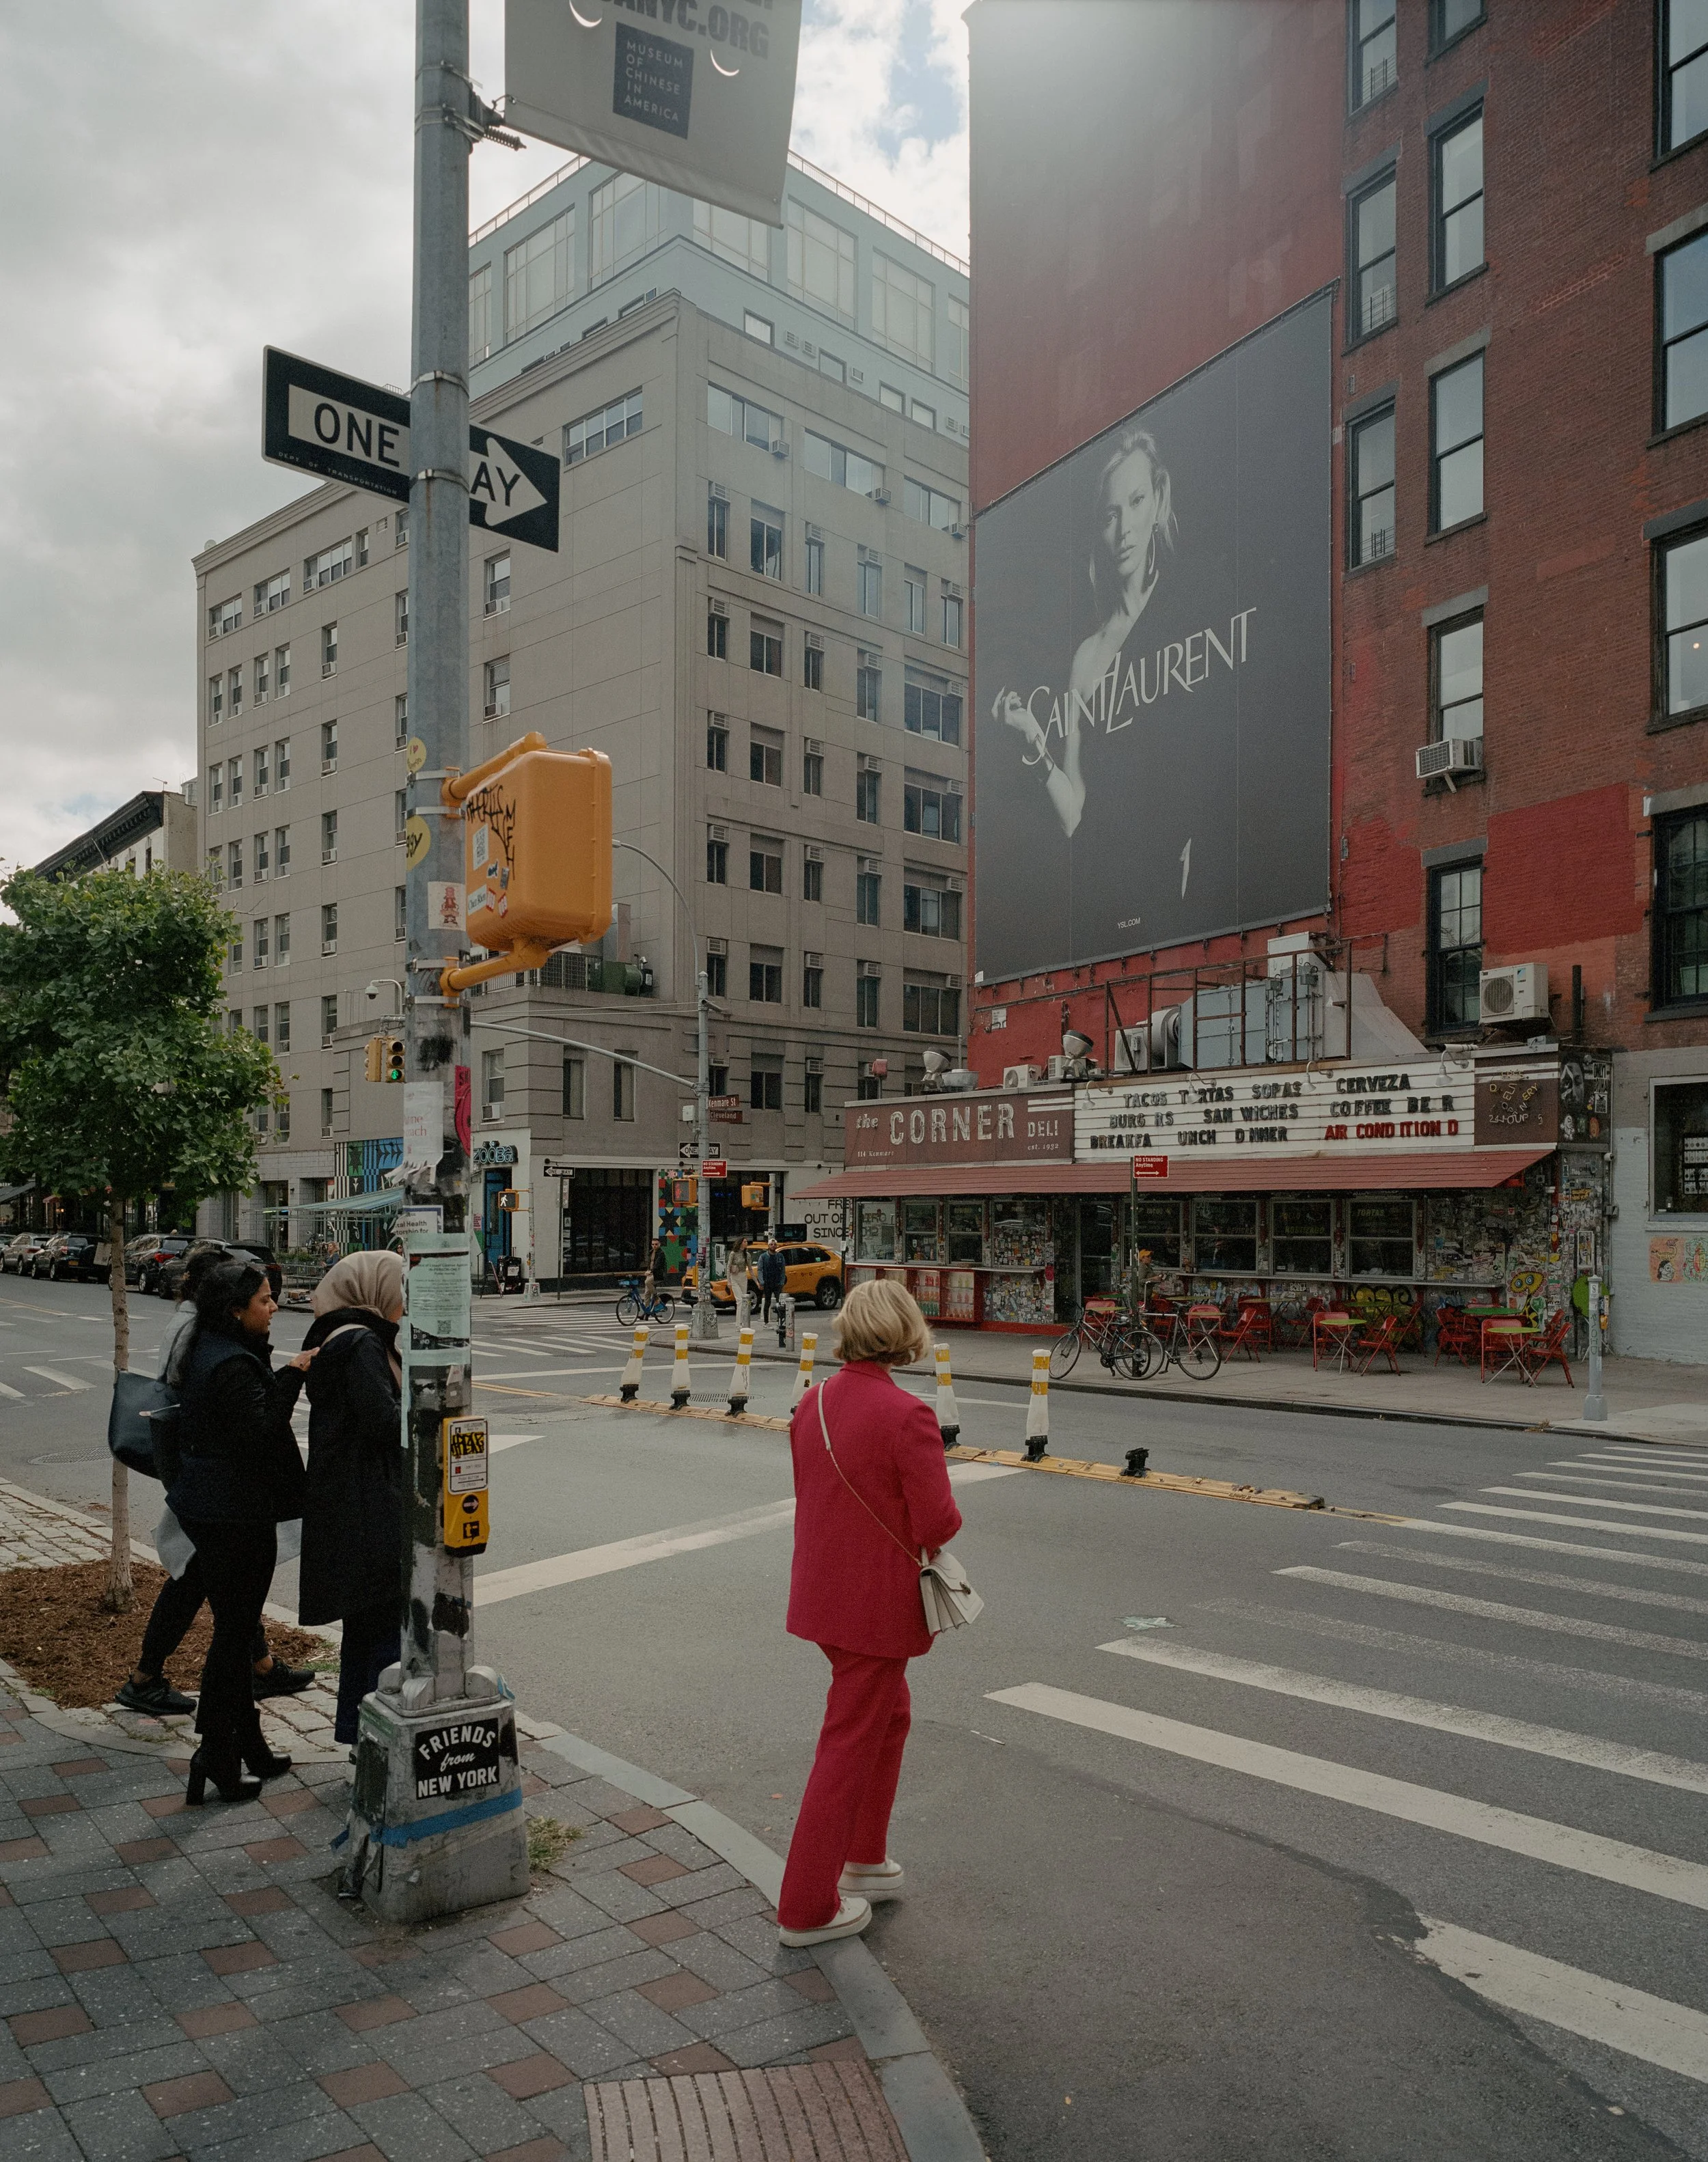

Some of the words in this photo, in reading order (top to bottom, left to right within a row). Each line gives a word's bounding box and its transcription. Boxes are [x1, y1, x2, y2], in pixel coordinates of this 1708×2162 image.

[626, 54, 643, 68] OF
[627, 40, 683, 68] MUSEUM
[626, 67, 680, 95] CHINESE
[627, 81, 641, 94] IN
[624, 95, 678, 122] AMERICA
[314, 402, 400, 467] ONE
[470, 461, 521, 507] AY
[328, 468, 397, 495] TRANSPORTATION
[1022, 670, 1116, 765] SAINT
[1105, 607, 1256, 734] LAURENT
[1117, 917, 1140, 929] YSL.COM
[708, 1099, 729, 1107] Kenmare
[730, 1097, 736, 1106] St
[1123, 1092, 1168, 1107] TACOS
[1179, 1086, 1234, 1105] TRTAS
[1252, 1081, 1302, 1099] SOPAS
[1336, 1074, 1411, 1093] CERVEZA
[1330, 1098, 1392, 1117] COFFEE
[855, 1113, 879, 1129] the
[890, 1103, 1015, 1145] CORNER
[1028, 1120, 1058, 1138] DELI
[1090, 1133, 1151, 1149] BREAKFA
[1178, 1129, 1216, 1146] UNCH
[1325, 1124, 1348, 1140] AIR
[804, 1213, 828, 1223] OUT
[418, 1726, 496, 1760] FRIENDS
[440, 1753, 476, 1772] from
[418, 1775, 452, 1797] NEW
[457, 1766, 497, 1789] YORK
